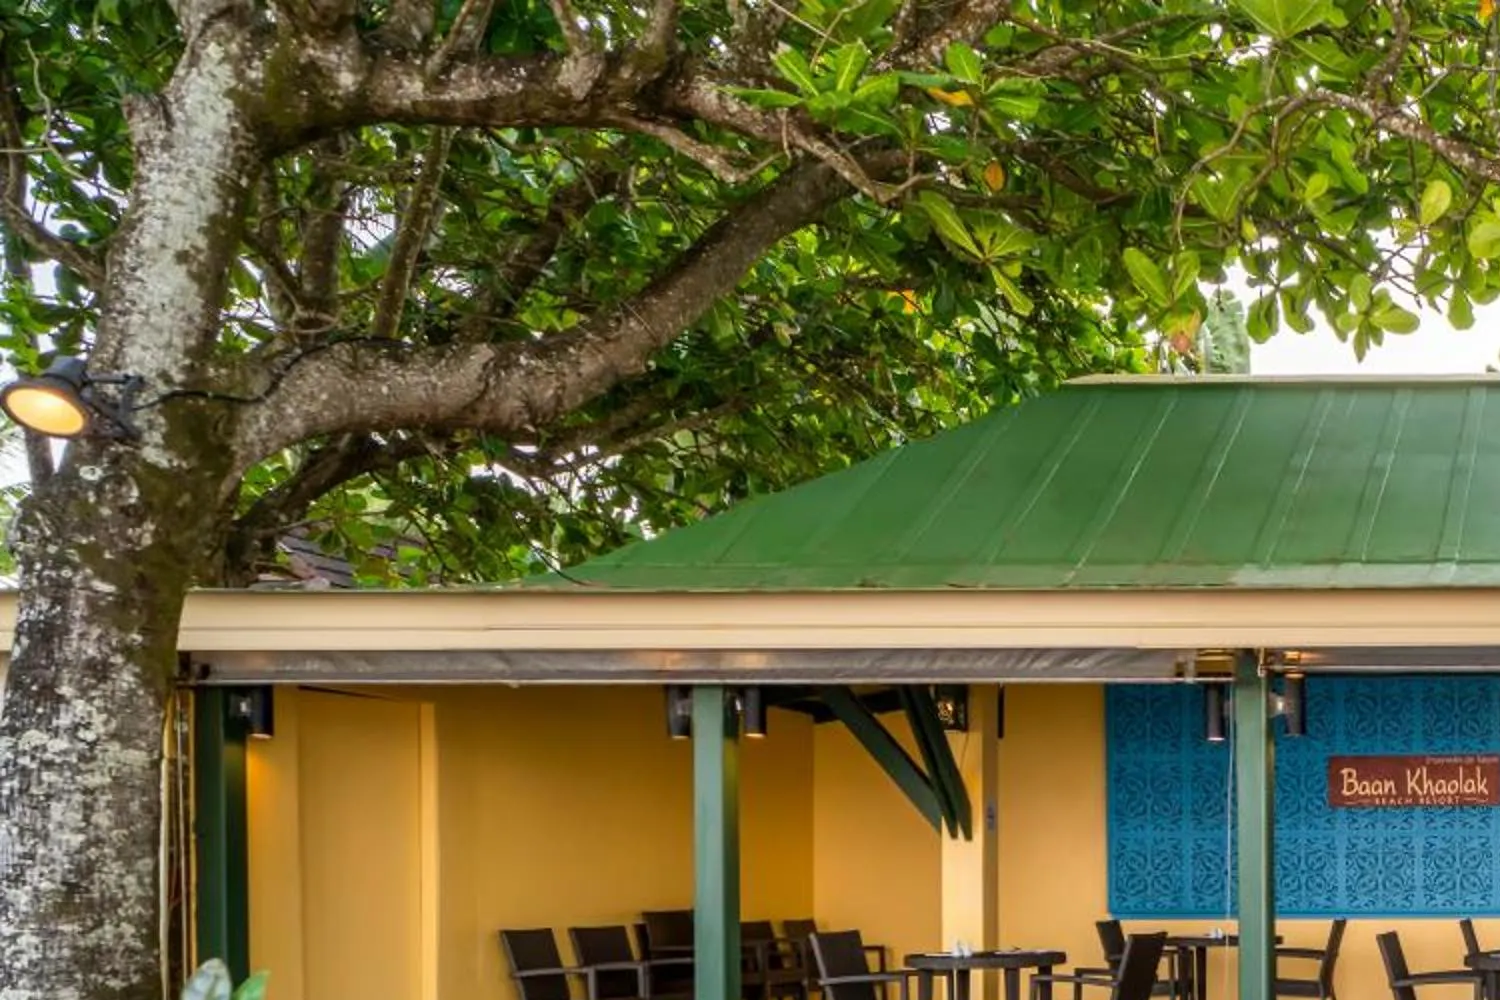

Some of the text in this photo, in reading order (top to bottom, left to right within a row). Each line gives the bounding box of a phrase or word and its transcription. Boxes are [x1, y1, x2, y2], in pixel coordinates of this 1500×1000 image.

[1340, 765, 1489, 797] Baan Khaolak
[1375, 796, 1460, 805] BEACH RESORT
